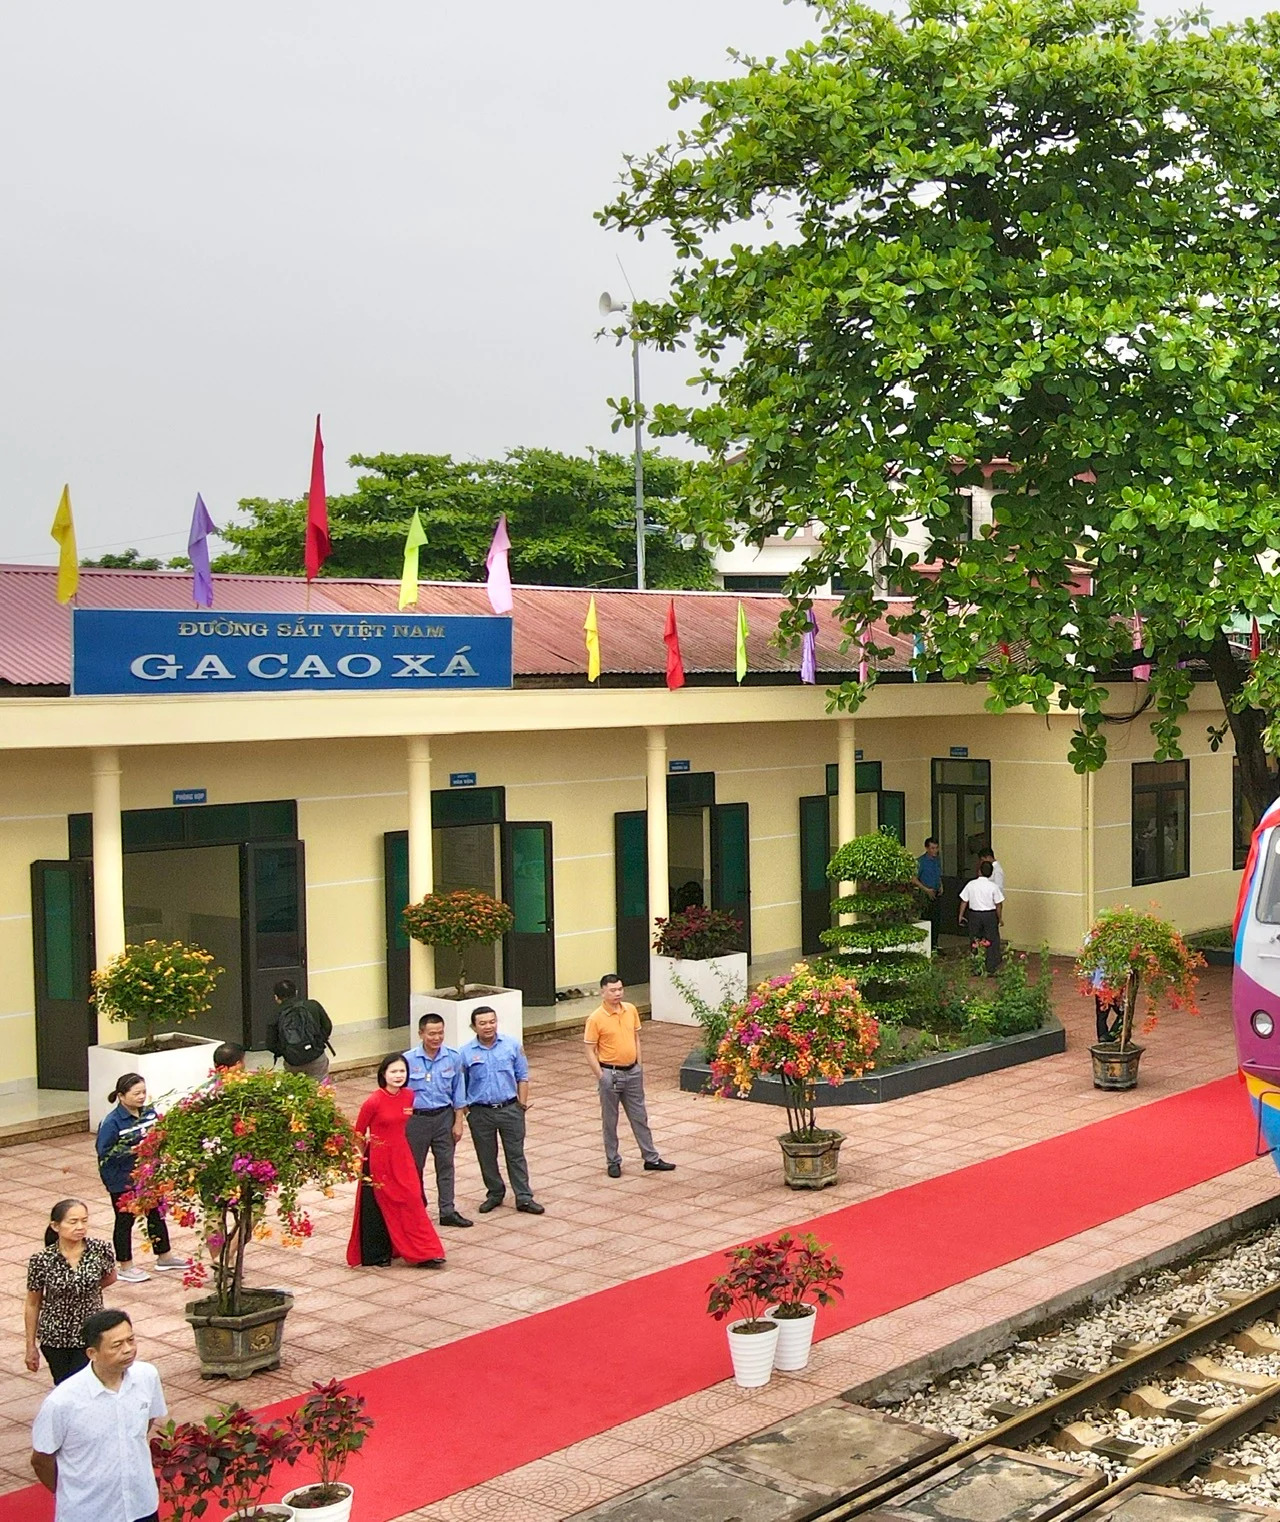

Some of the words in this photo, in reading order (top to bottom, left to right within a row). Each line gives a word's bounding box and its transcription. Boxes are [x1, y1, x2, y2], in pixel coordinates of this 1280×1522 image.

[178, 618, 269, 638] ĐƯỜNG
[277, 616, 323, 638] SẮT
[330, 622, 386, 641] VIỆT
[392, 623, 446, 639] NAM
[130, 653, 236, 680] GA
[247, 653, 382, 679] CAO
[391, 645, 480, 678] XÁ
